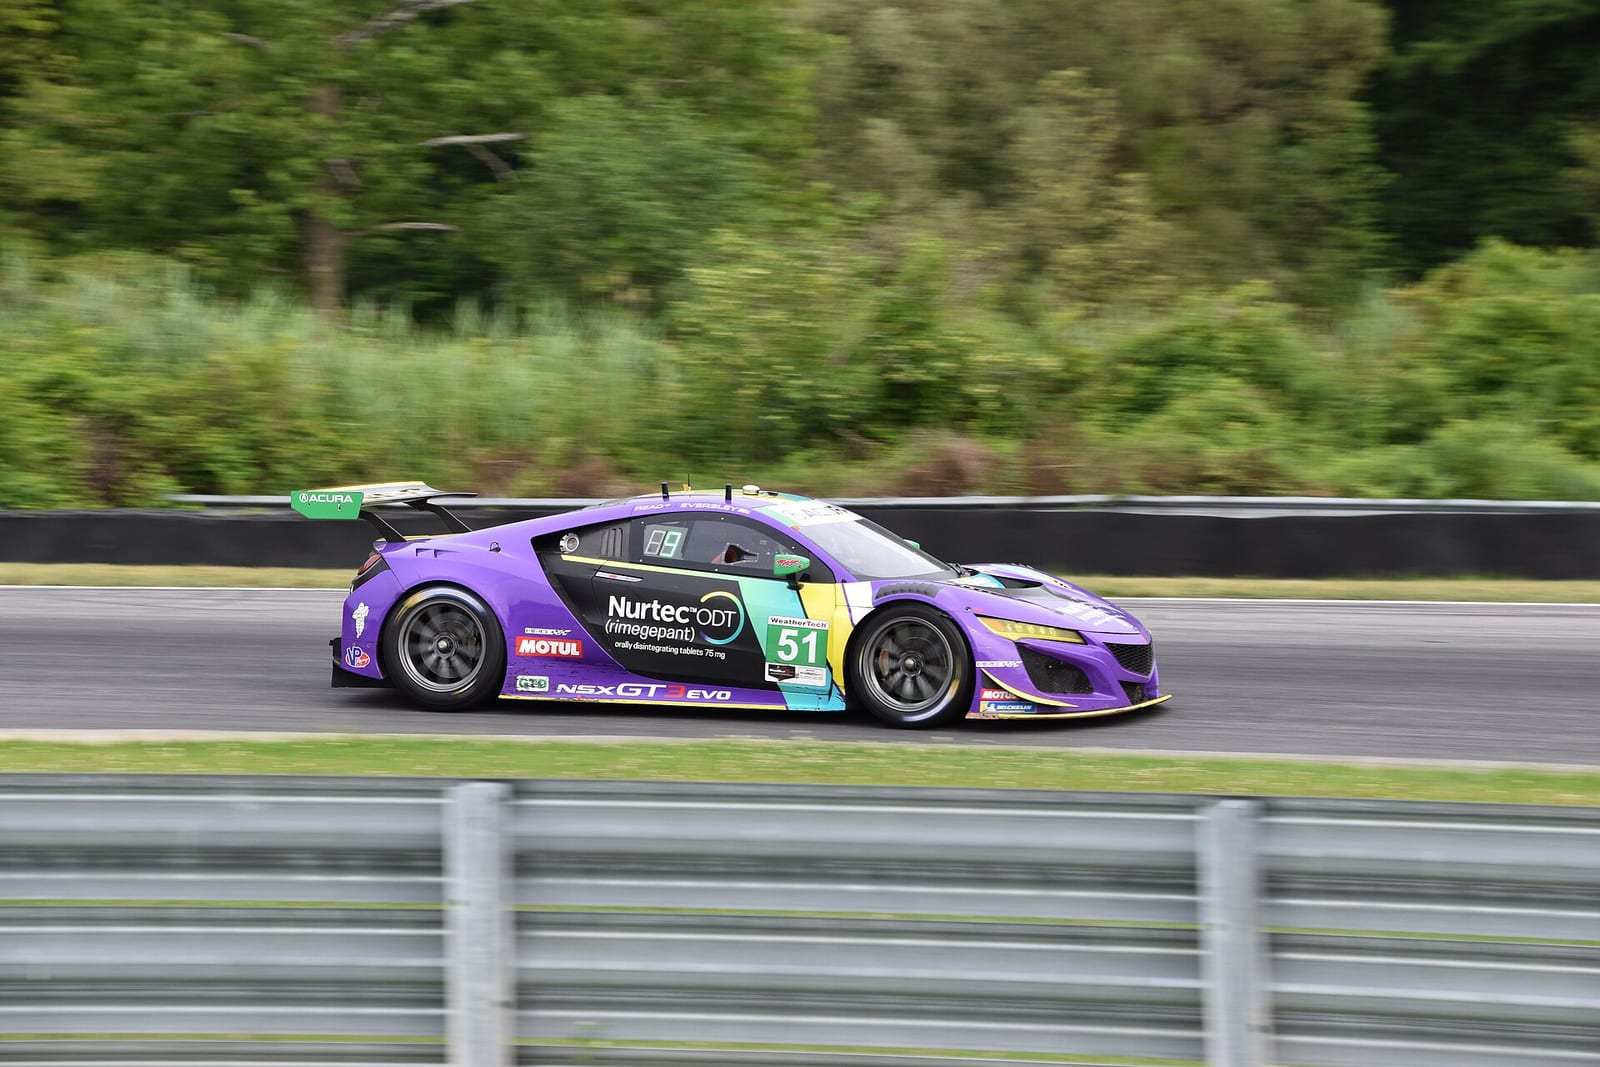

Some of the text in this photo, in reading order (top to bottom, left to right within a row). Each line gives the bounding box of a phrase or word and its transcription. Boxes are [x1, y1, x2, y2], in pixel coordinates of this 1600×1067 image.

[308, 493, 353, 504] ACURA
[696, 608, 737, 628] ODT
[771, 617, 827, 628] WeatherTech
[605, 618, 695, 642] (rimegepant)
[518, 639, 580, 656] MOTUL
[615, 641, 726, 660] orally disintegrating tablets 75 mg
[777, 628, 817, 663] 51
[556, 682, 732, 700] NSX GT3 EVO
